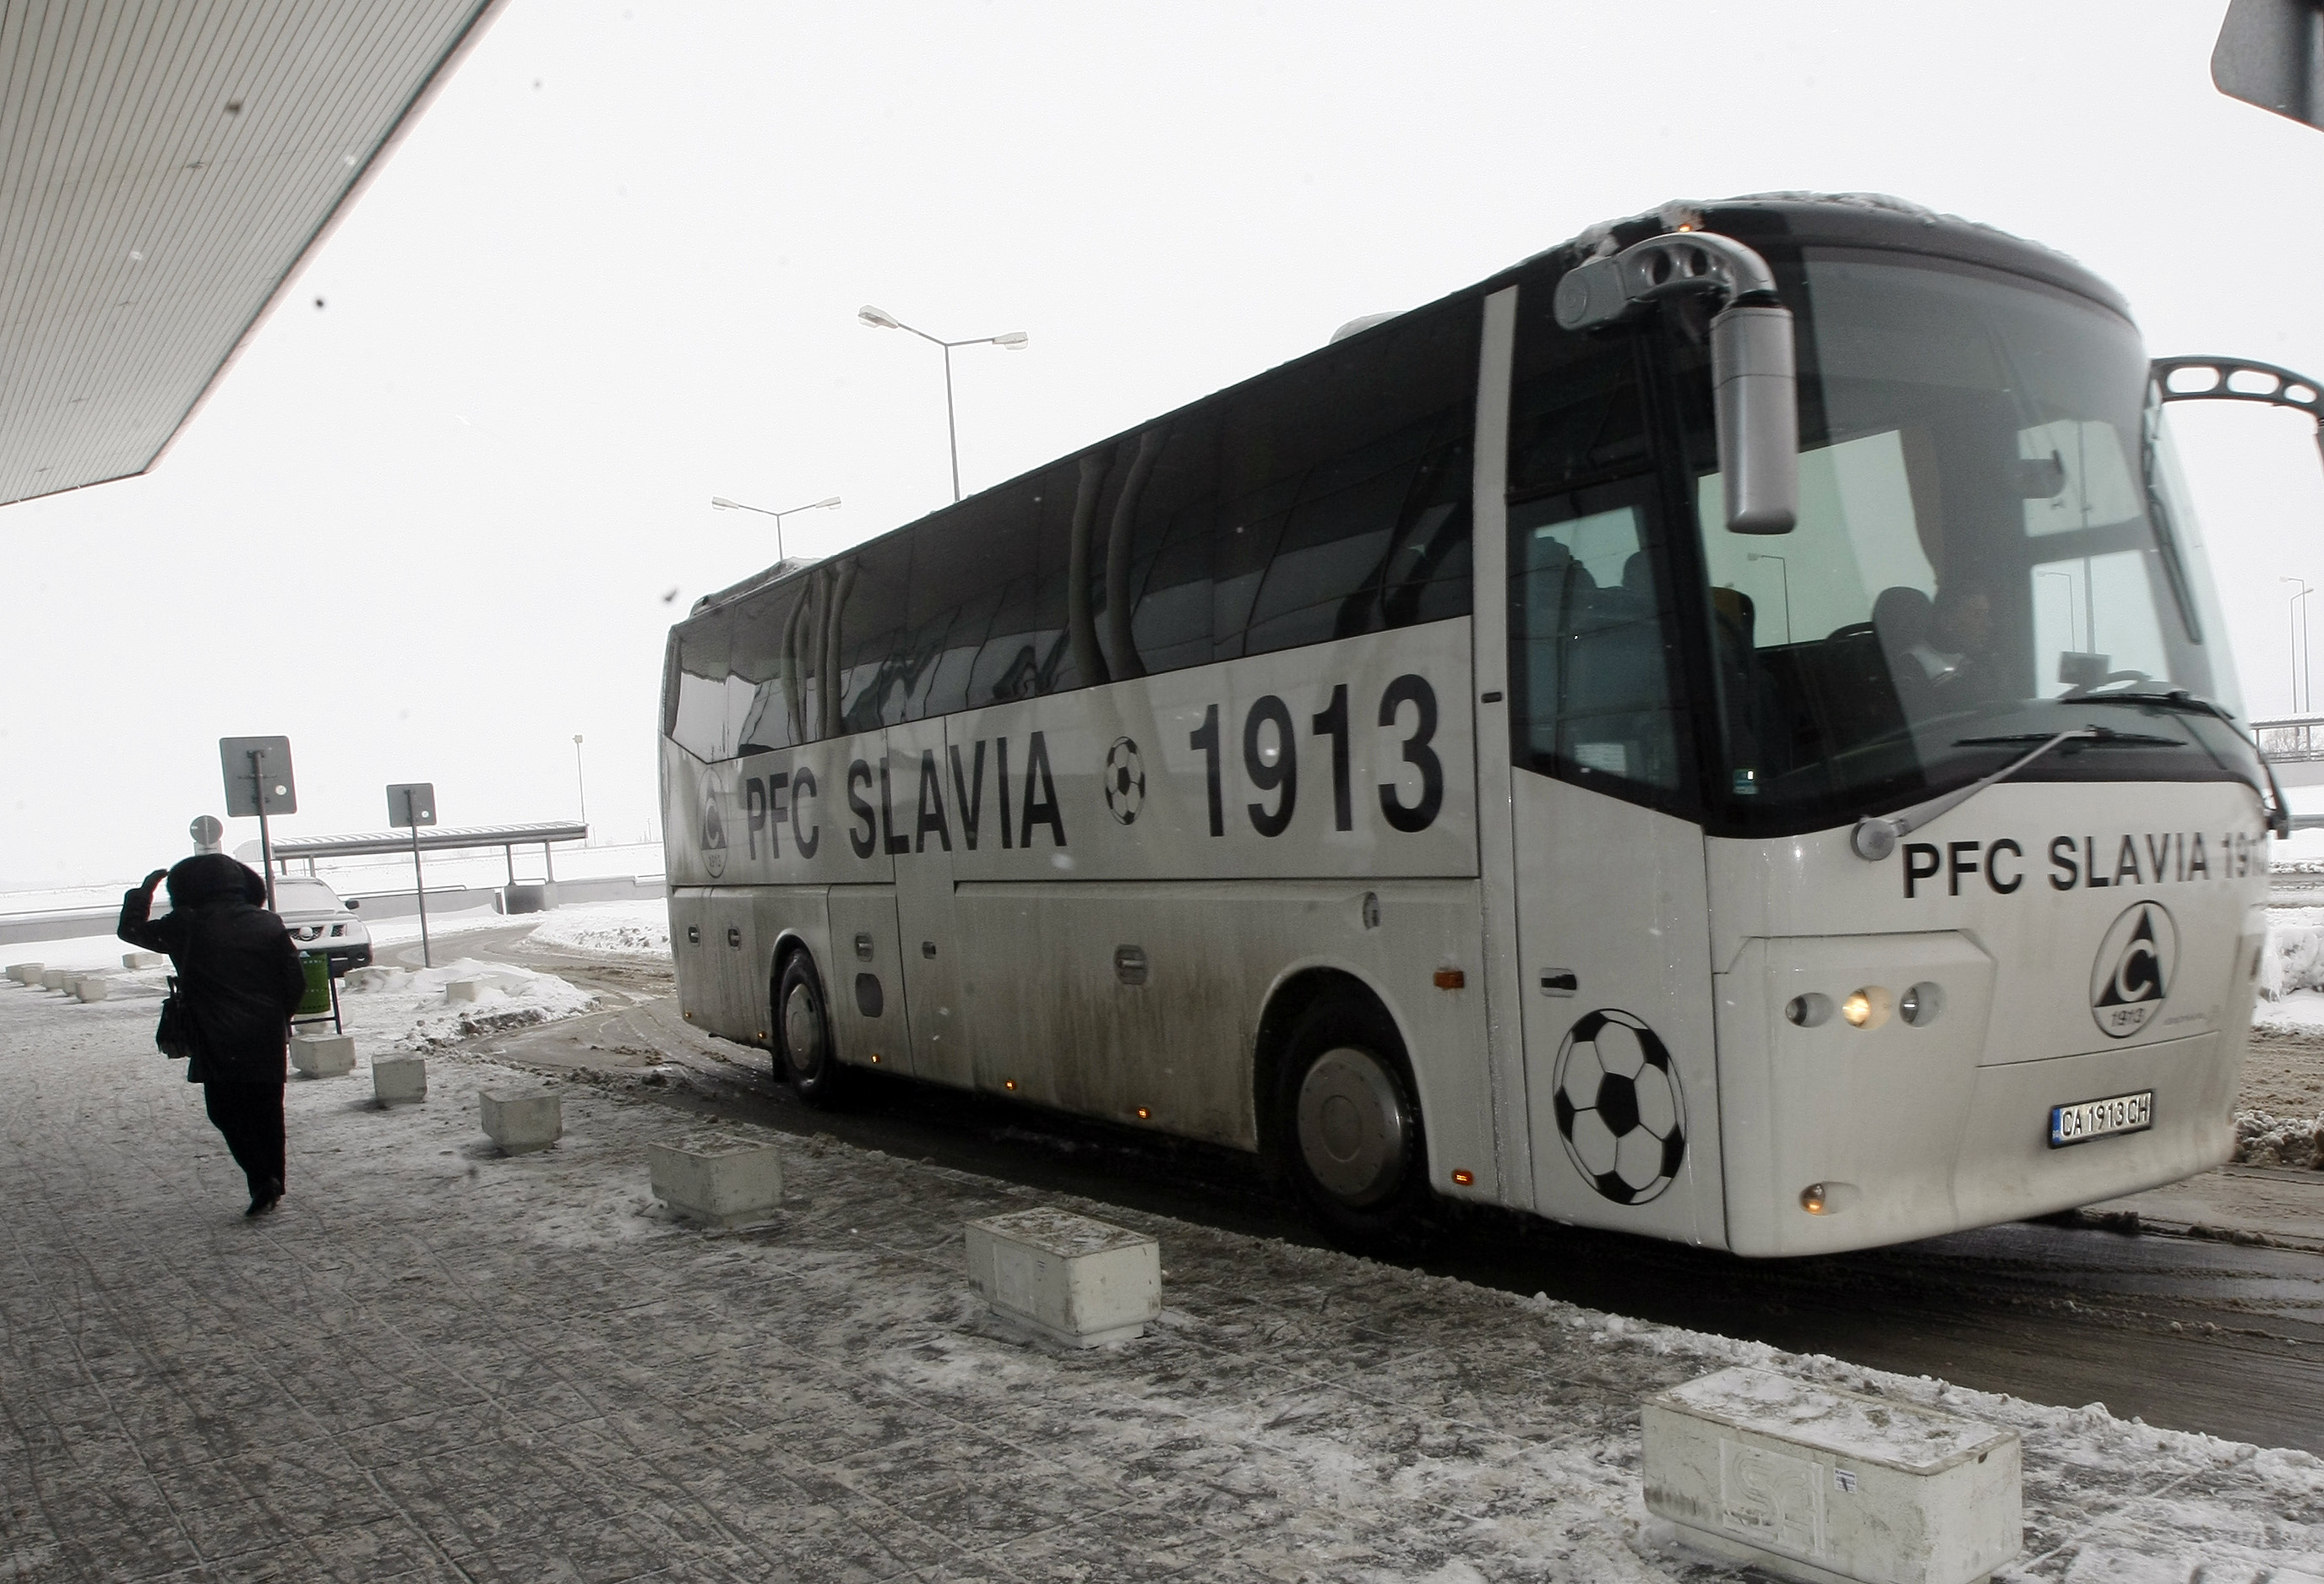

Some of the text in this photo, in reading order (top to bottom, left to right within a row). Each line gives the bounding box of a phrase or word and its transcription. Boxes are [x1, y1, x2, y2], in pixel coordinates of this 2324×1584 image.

[747, 673, 1444, 860] PFC SLAVIA 1913
[1902, 838, 2024, 898] PFC
[2048, 832, 2210, 890] SLAVIA
[2112, 1007, 2144, 1027] 1913
[2061, 1097, 2147, 1137] CA 1913 CH
